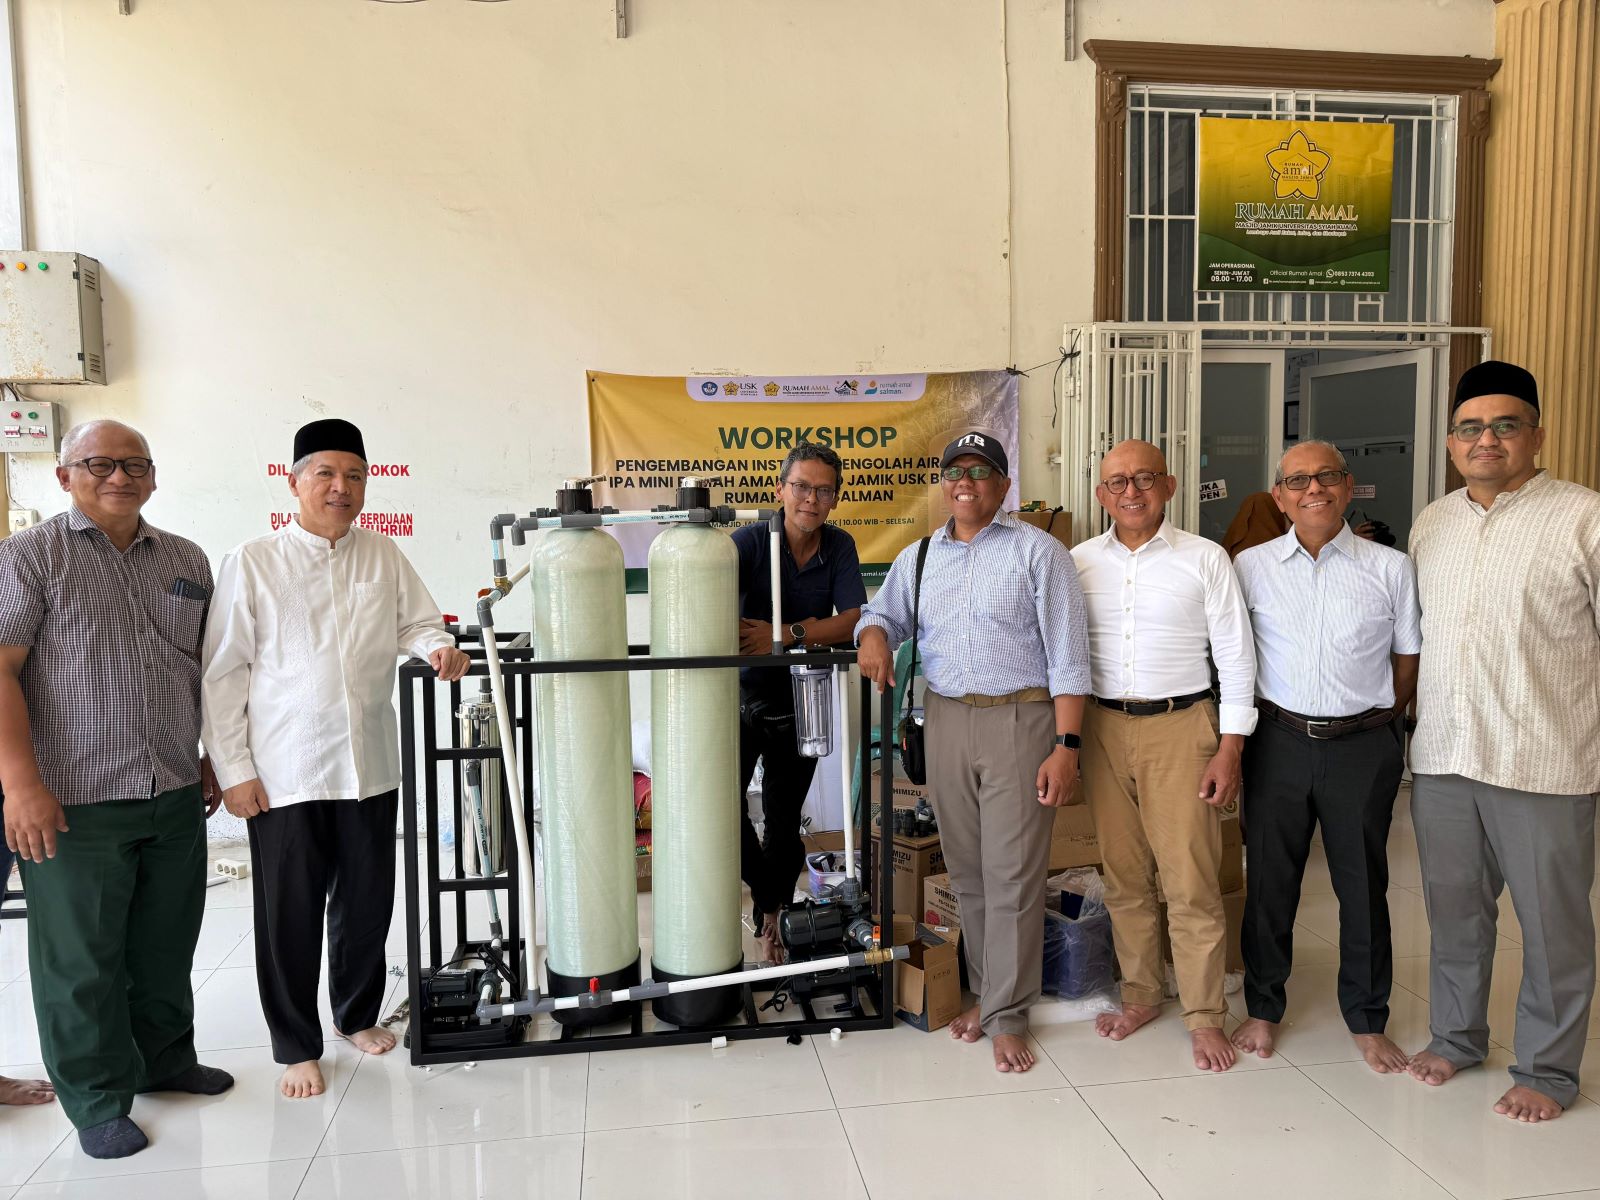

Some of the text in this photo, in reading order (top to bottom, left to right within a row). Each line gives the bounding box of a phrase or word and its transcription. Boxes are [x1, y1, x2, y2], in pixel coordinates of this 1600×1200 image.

[1235, 202, 1358, 222] RUMAH AMAL
[719, 426, 897, 449] WORKSHOP
[958, 434, 985, 447] ITB
[616, 459, 748, 472] PENGEMBANGAN
[842, 458, 913, 470] ENGOLAH
[917, 457, 940, 468] AIR
[610, 477, 635, 488] IPA
[639, 476, 673, 488] MINI
[847, 475, 894, 486] JAMIK
[898, 474, 927, 485] USK
[1200, 491, 1220, 501] PEN
[360, 512, 413, 525] BERDUAAN
[893, 788, 921, 797] HIMIZU
